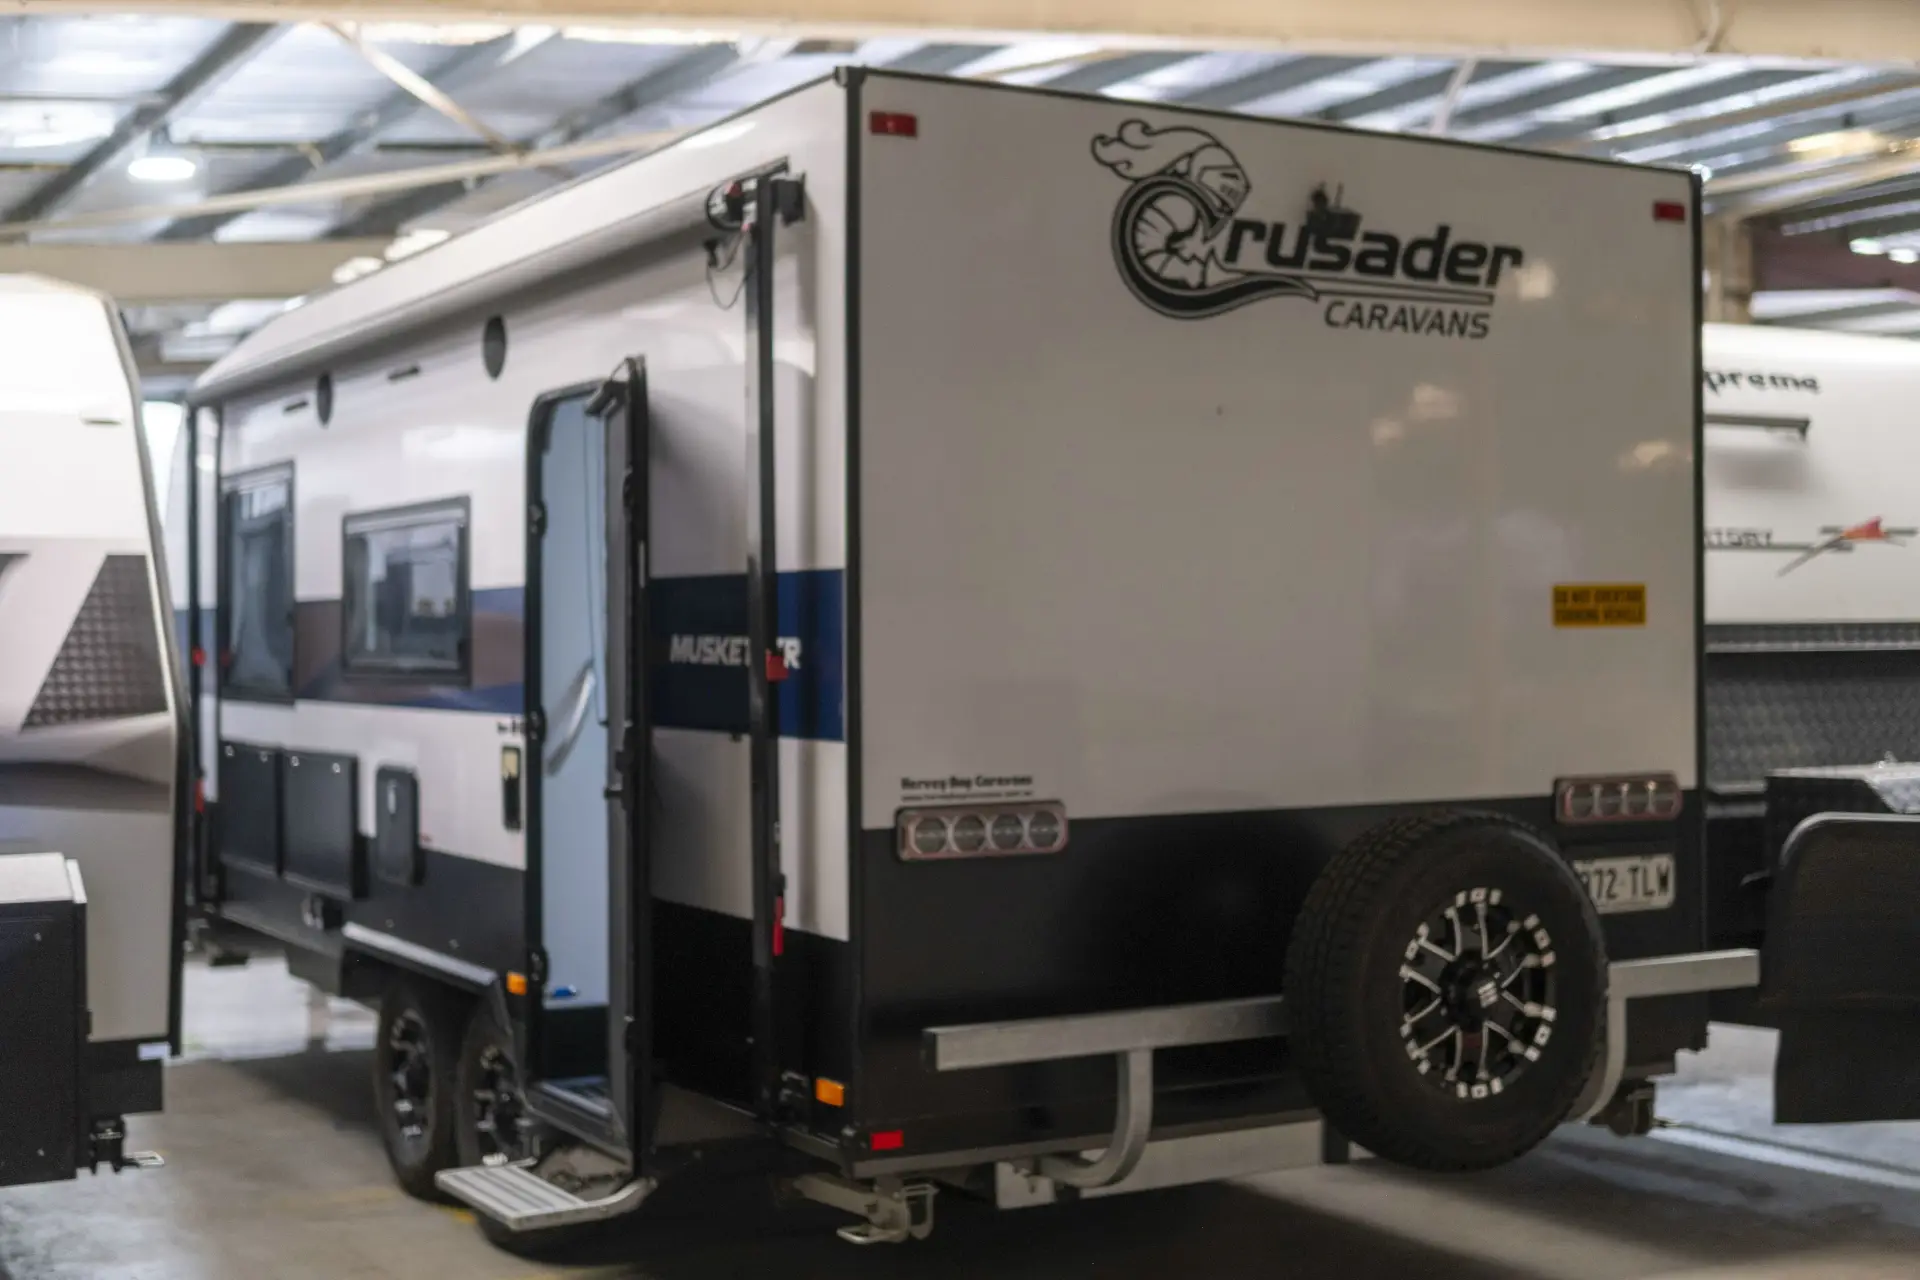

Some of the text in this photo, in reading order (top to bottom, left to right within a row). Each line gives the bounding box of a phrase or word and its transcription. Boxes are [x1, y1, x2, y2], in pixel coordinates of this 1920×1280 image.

[1324, 300, 1491, 339] CARAVANS
[1702, 370, 1821, 396] preme
[669, 633, 802, 669] MUSKETR
